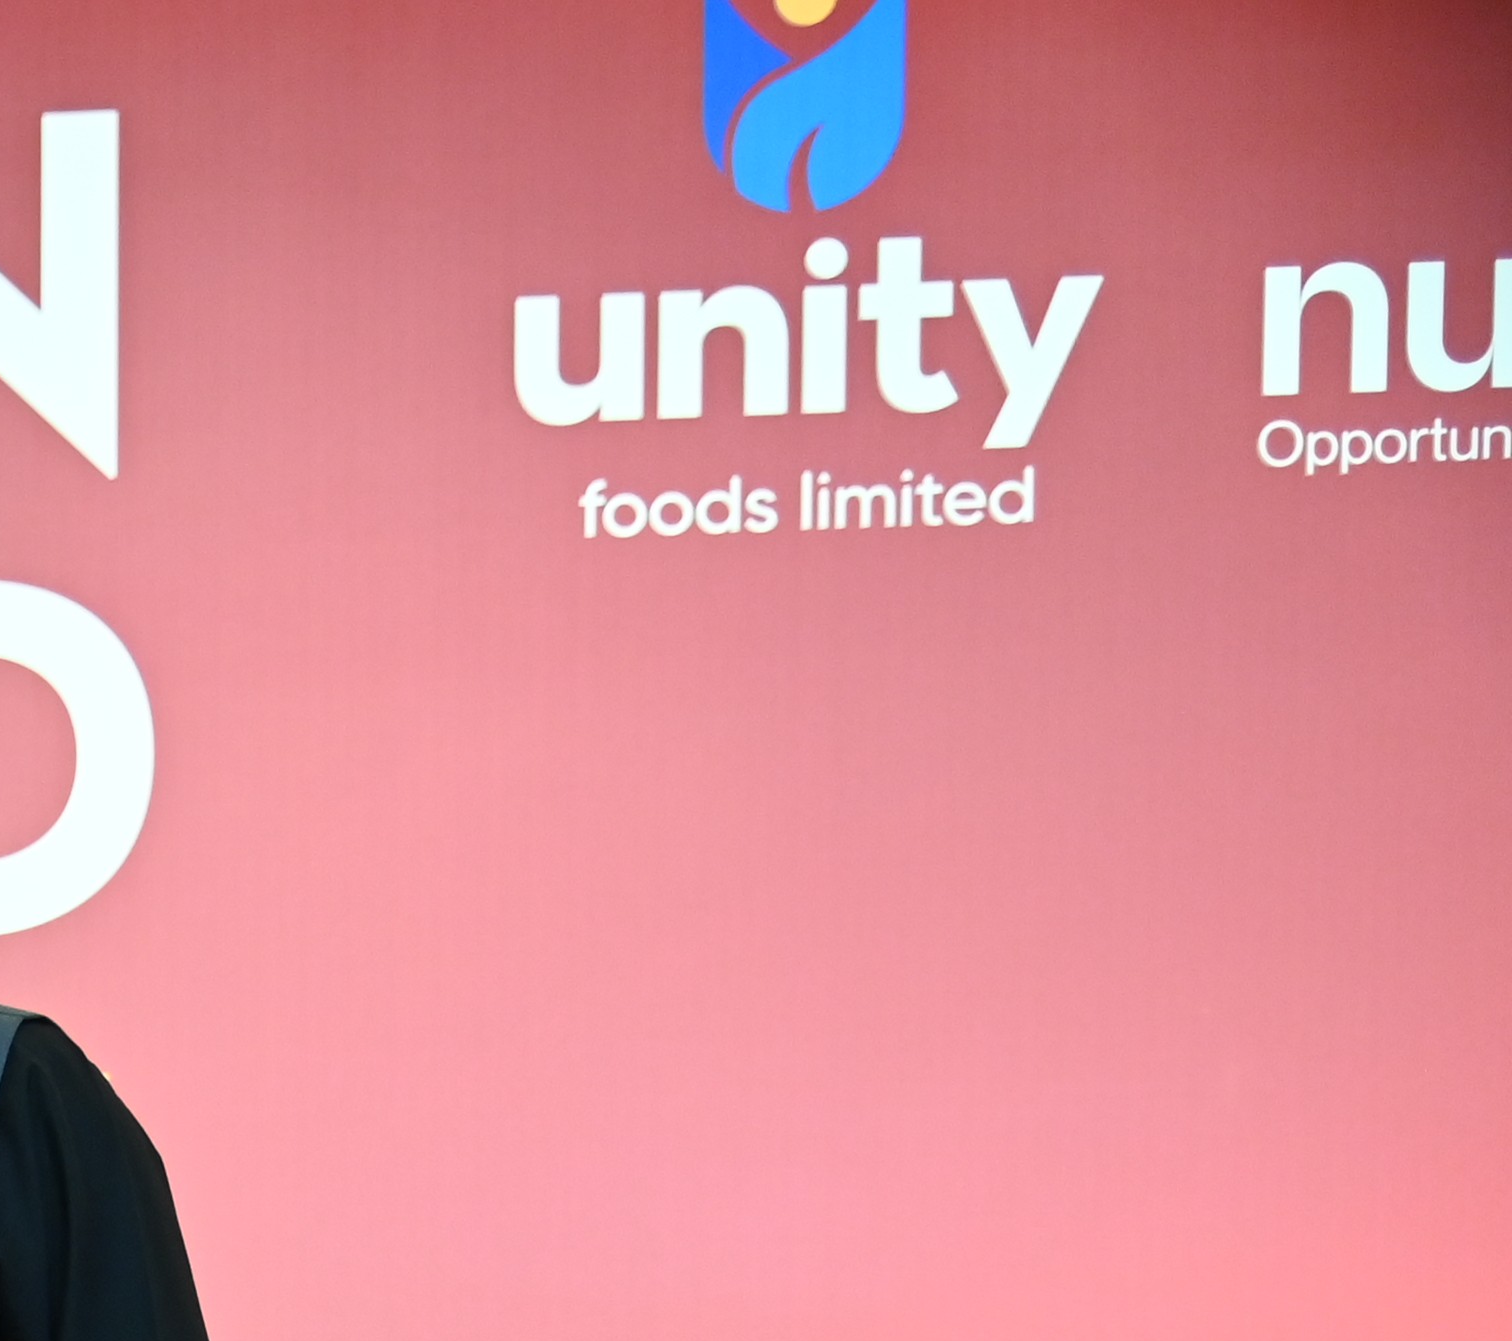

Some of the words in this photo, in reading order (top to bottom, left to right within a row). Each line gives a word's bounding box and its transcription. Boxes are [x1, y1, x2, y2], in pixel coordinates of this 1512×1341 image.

[514, 237, 1104, 449] unity
[579, 475, 778, 538] foods
[800, 466, 1035, 530] limited
